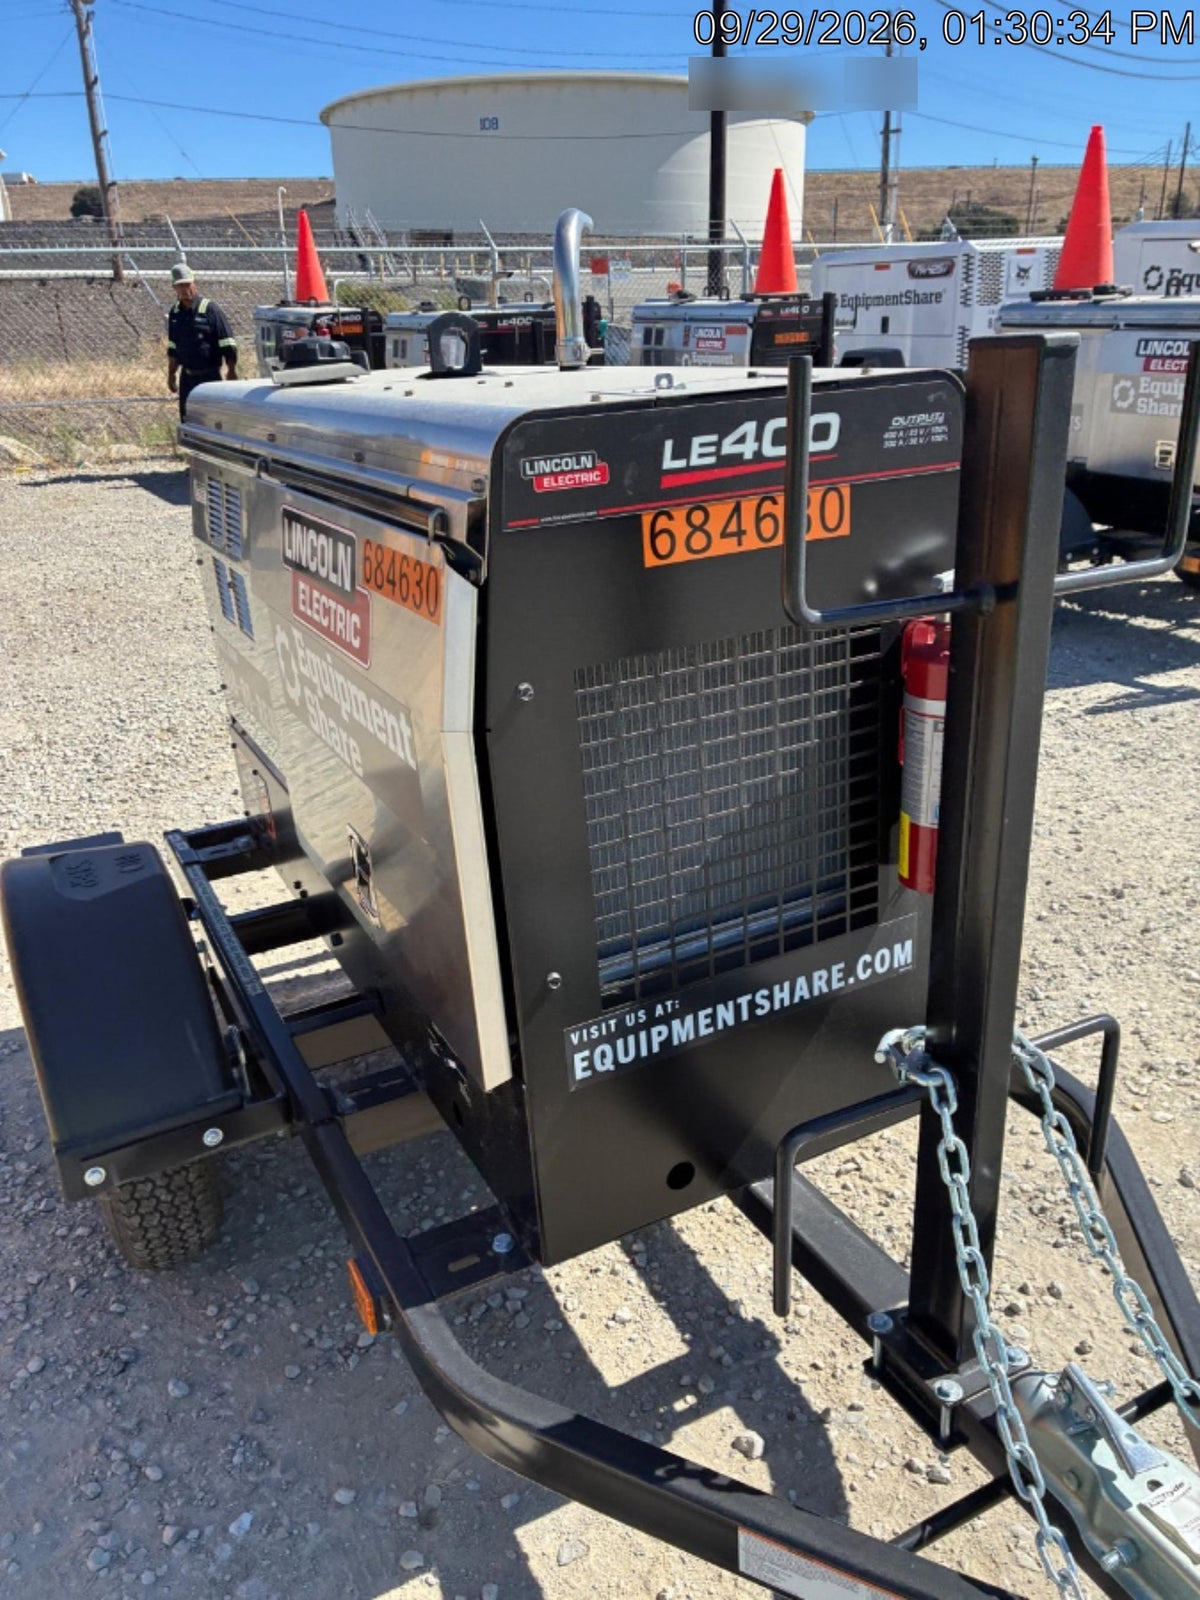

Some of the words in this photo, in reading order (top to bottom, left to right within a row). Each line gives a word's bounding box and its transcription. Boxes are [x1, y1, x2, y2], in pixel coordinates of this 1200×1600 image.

[480, 116, 499, 131] 108
[839, 289, 944, 312] EquipmentShare
[525, 455, 594, 476] LINCOLN
[662, 411, 842, 470] LE400
[543, 471, 602, 488] ELECTRIC
[283, 517, 352, 593] LINCOLN
[363, 538, 440, 618] 684630
[299, 580, 361, 649] ELECTRIC
[291, 624, 417, 771] Equipment
[304, 688, 364, 778] Share
[569, 1018, 618, 1045] VISIT
[625, 1008, 647, 1027] US
[655, 1000, 680, 1018] AT:
[573, 938, 914, 1082] EQUIPMENTSHARE.COM
